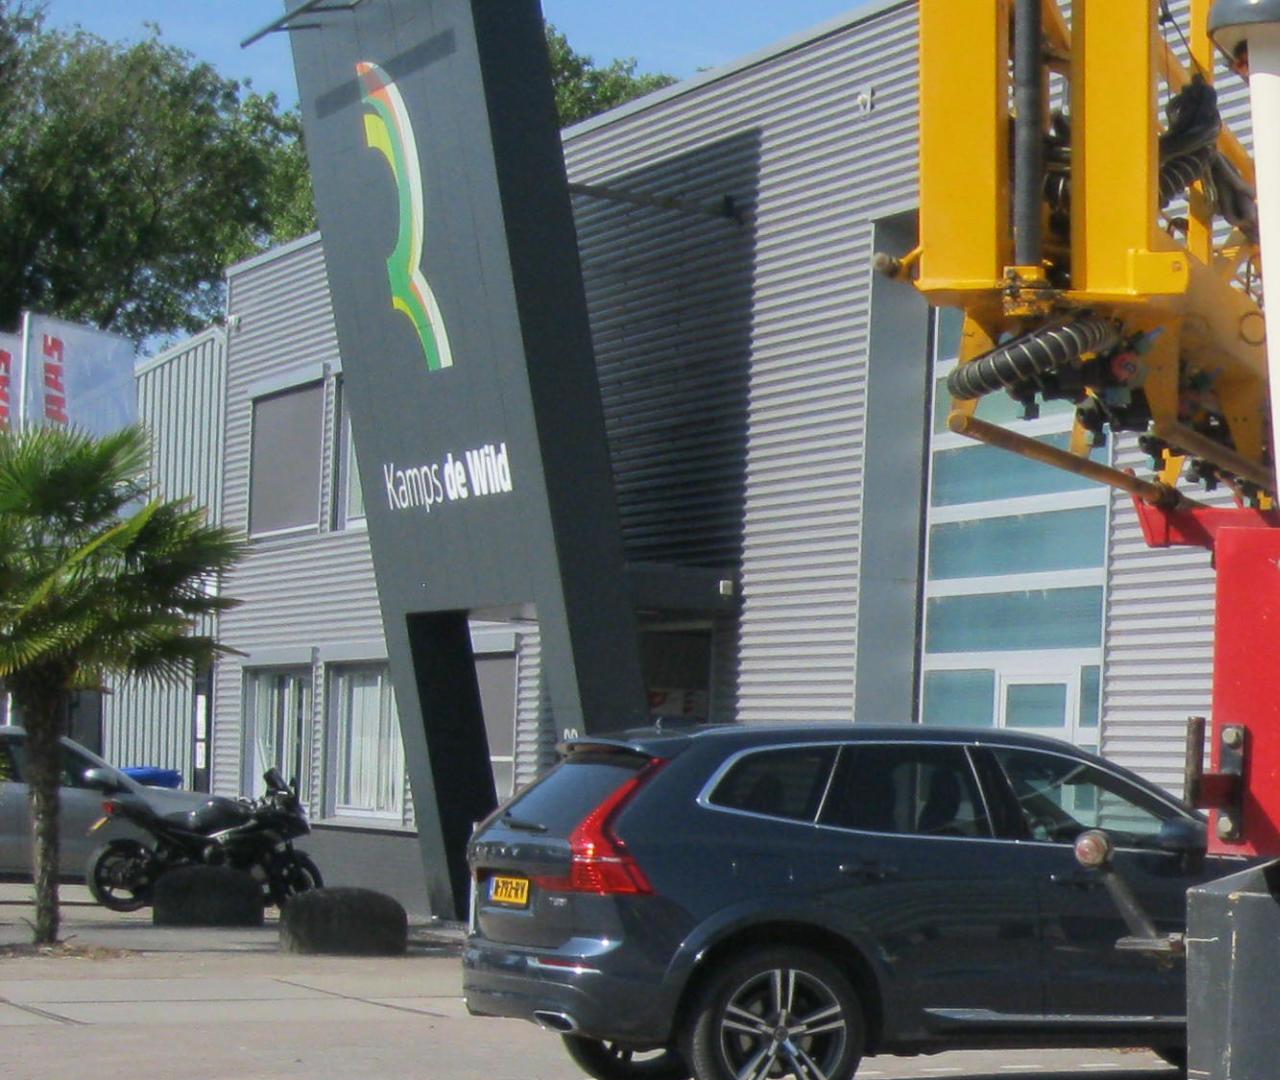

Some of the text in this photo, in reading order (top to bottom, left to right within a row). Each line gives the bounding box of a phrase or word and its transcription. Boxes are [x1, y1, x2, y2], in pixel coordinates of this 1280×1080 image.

[384, 442, 513, 512] Kamps de Wild
